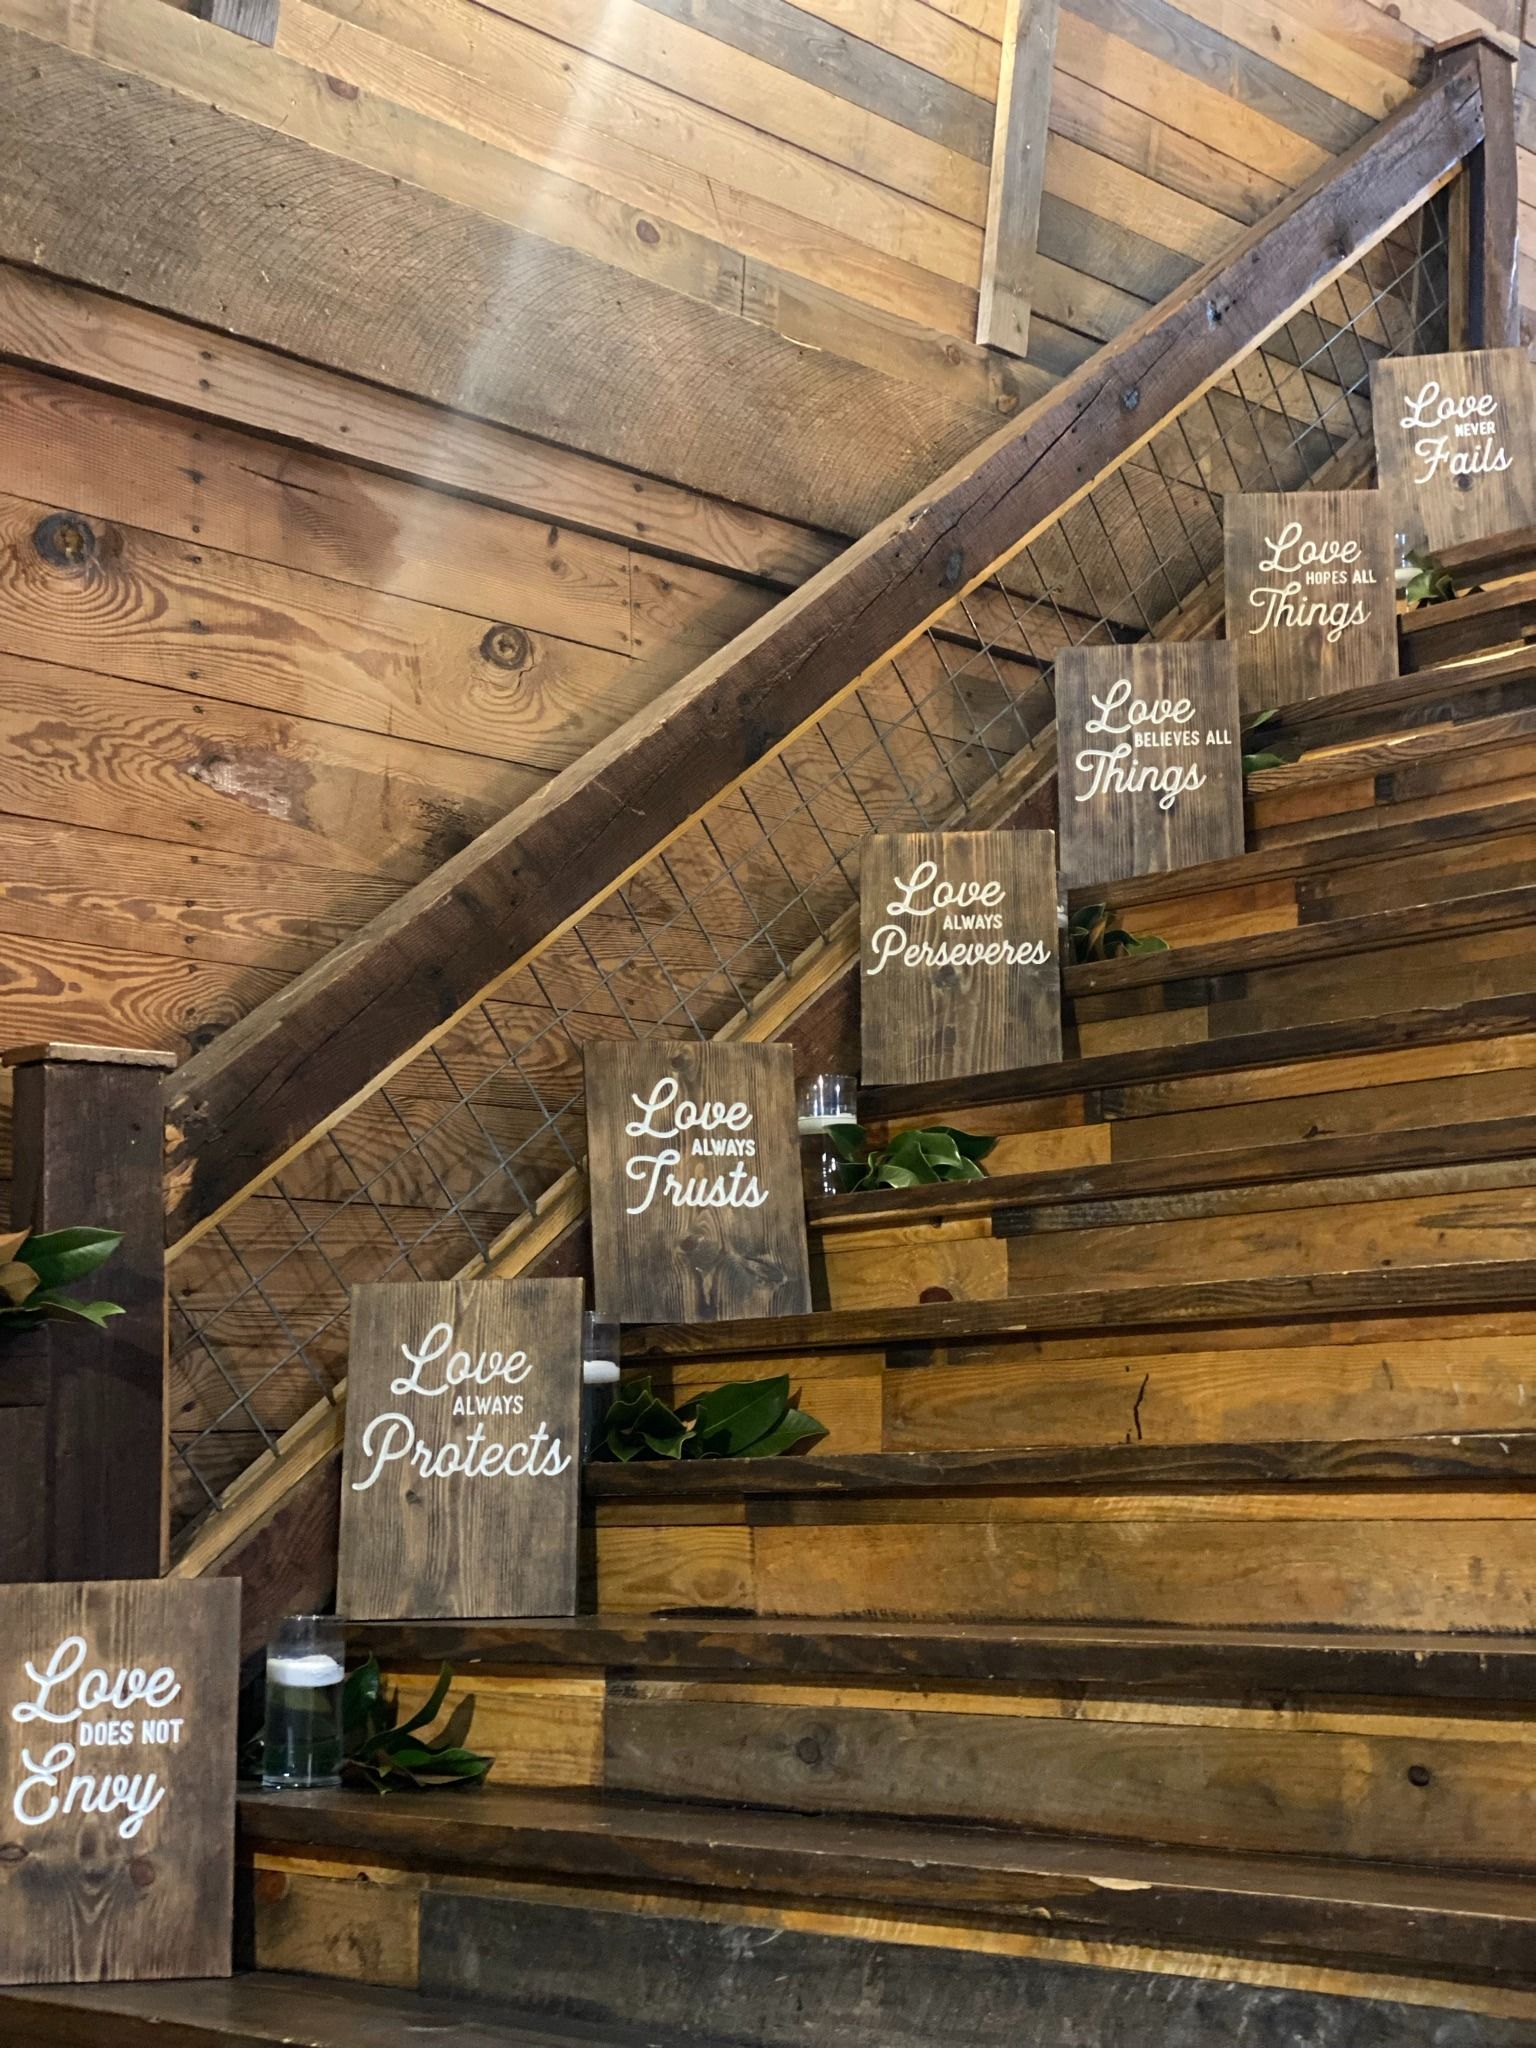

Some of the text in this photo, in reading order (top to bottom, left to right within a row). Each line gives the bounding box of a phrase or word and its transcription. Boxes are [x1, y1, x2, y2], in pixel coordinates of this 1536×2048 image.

[1400, 381, 1497, 429] Love
[1455, 421, 1496, 438] NEVER
[1414, 435, 1514, 484] Fails
[1259, 522, 1362, 573] Love
[1306, 569, 1377, 585] HOPES ALL
[1249, 581, 1371, 643] Things
[1086, 678, 1195, 734] Love
[1134, 730, 1232, 748] BELIEVES ALL
[1075, 743, 1206, 810] Things
[887, 860, 1005, 916] Love
[943, 914, 1002, 931] ALWAYS
[867, 924, 1051, 976] Perseveres
[625, 1077, 753, 1139] Love
[691, 1138, 756, 1156] ALWAYS
[626, 1149, 769, 1215] Trusts
[391, 1322, 533, 1397] Love
[453, 1394, 524, 1416] ALWAYS
[352, 1412, 572, 1491] Protects
[11, 1636, 181, 1723] Love
[79, 1718, 184, 1747] DOES NOT
[13, 1742, 166, 1840] Envy
